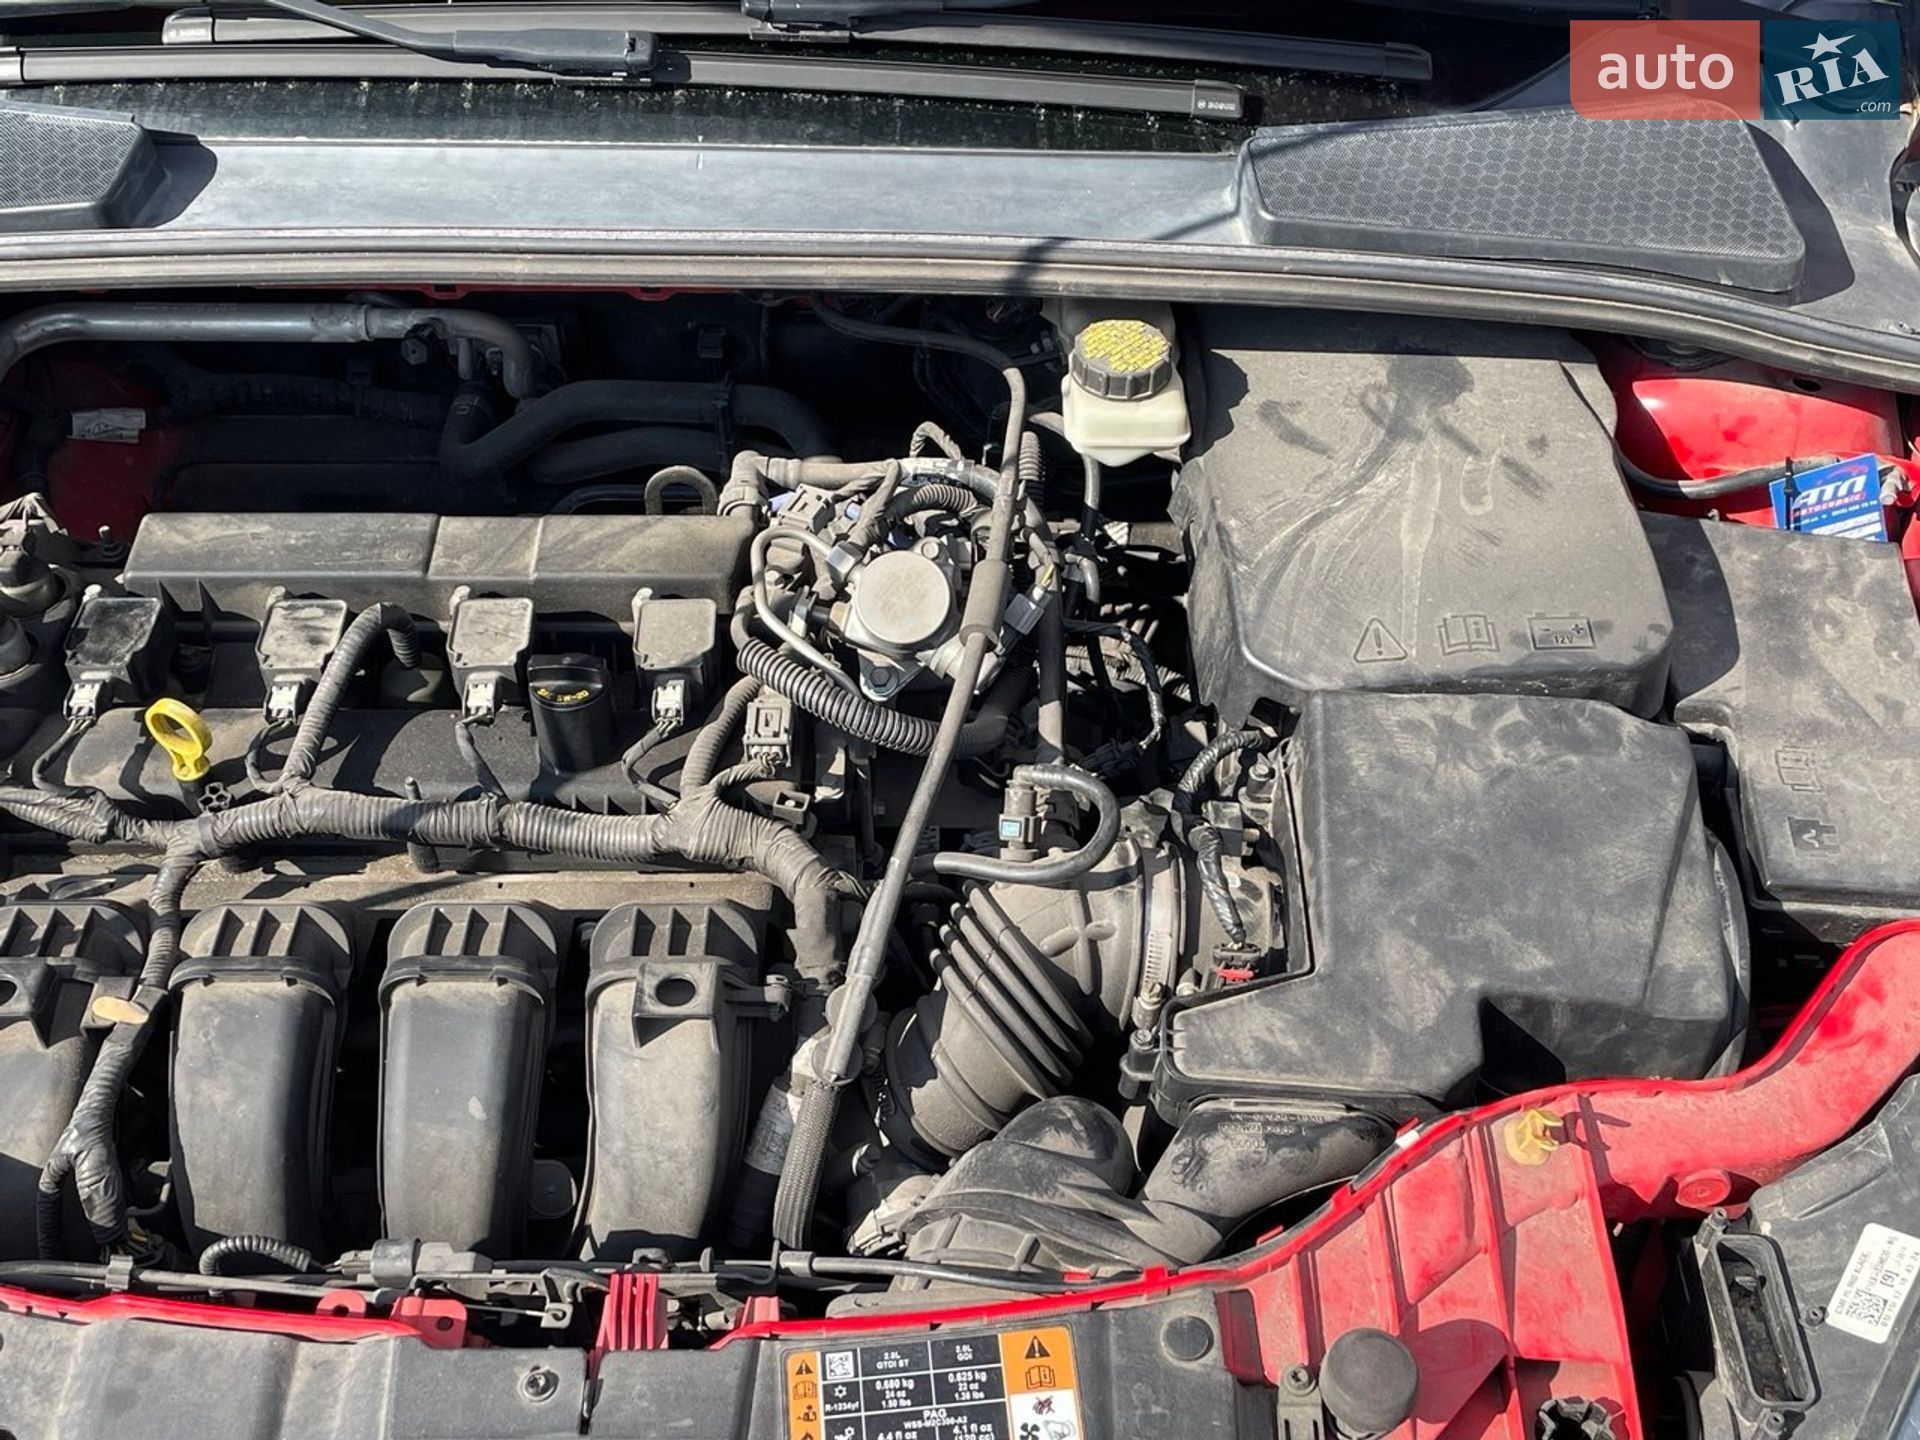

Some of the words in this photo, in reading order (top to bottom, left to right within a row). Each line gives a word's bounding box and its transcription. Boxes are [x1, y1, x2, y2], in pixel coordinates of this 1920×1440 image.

[1553, 635, 1574, 645] 12V
[974, 1370, 987, 1382] kg
[901, 1378, 914, 1390] kg
[972, 1391, 985, 1399] lbs
[899, 1398, 911, 1407] lbs
[923, 1408, 947, 1419] PAG
[953, 1424, 968, 1434] 4.1
[980, 1424, 992, 1432] oz
